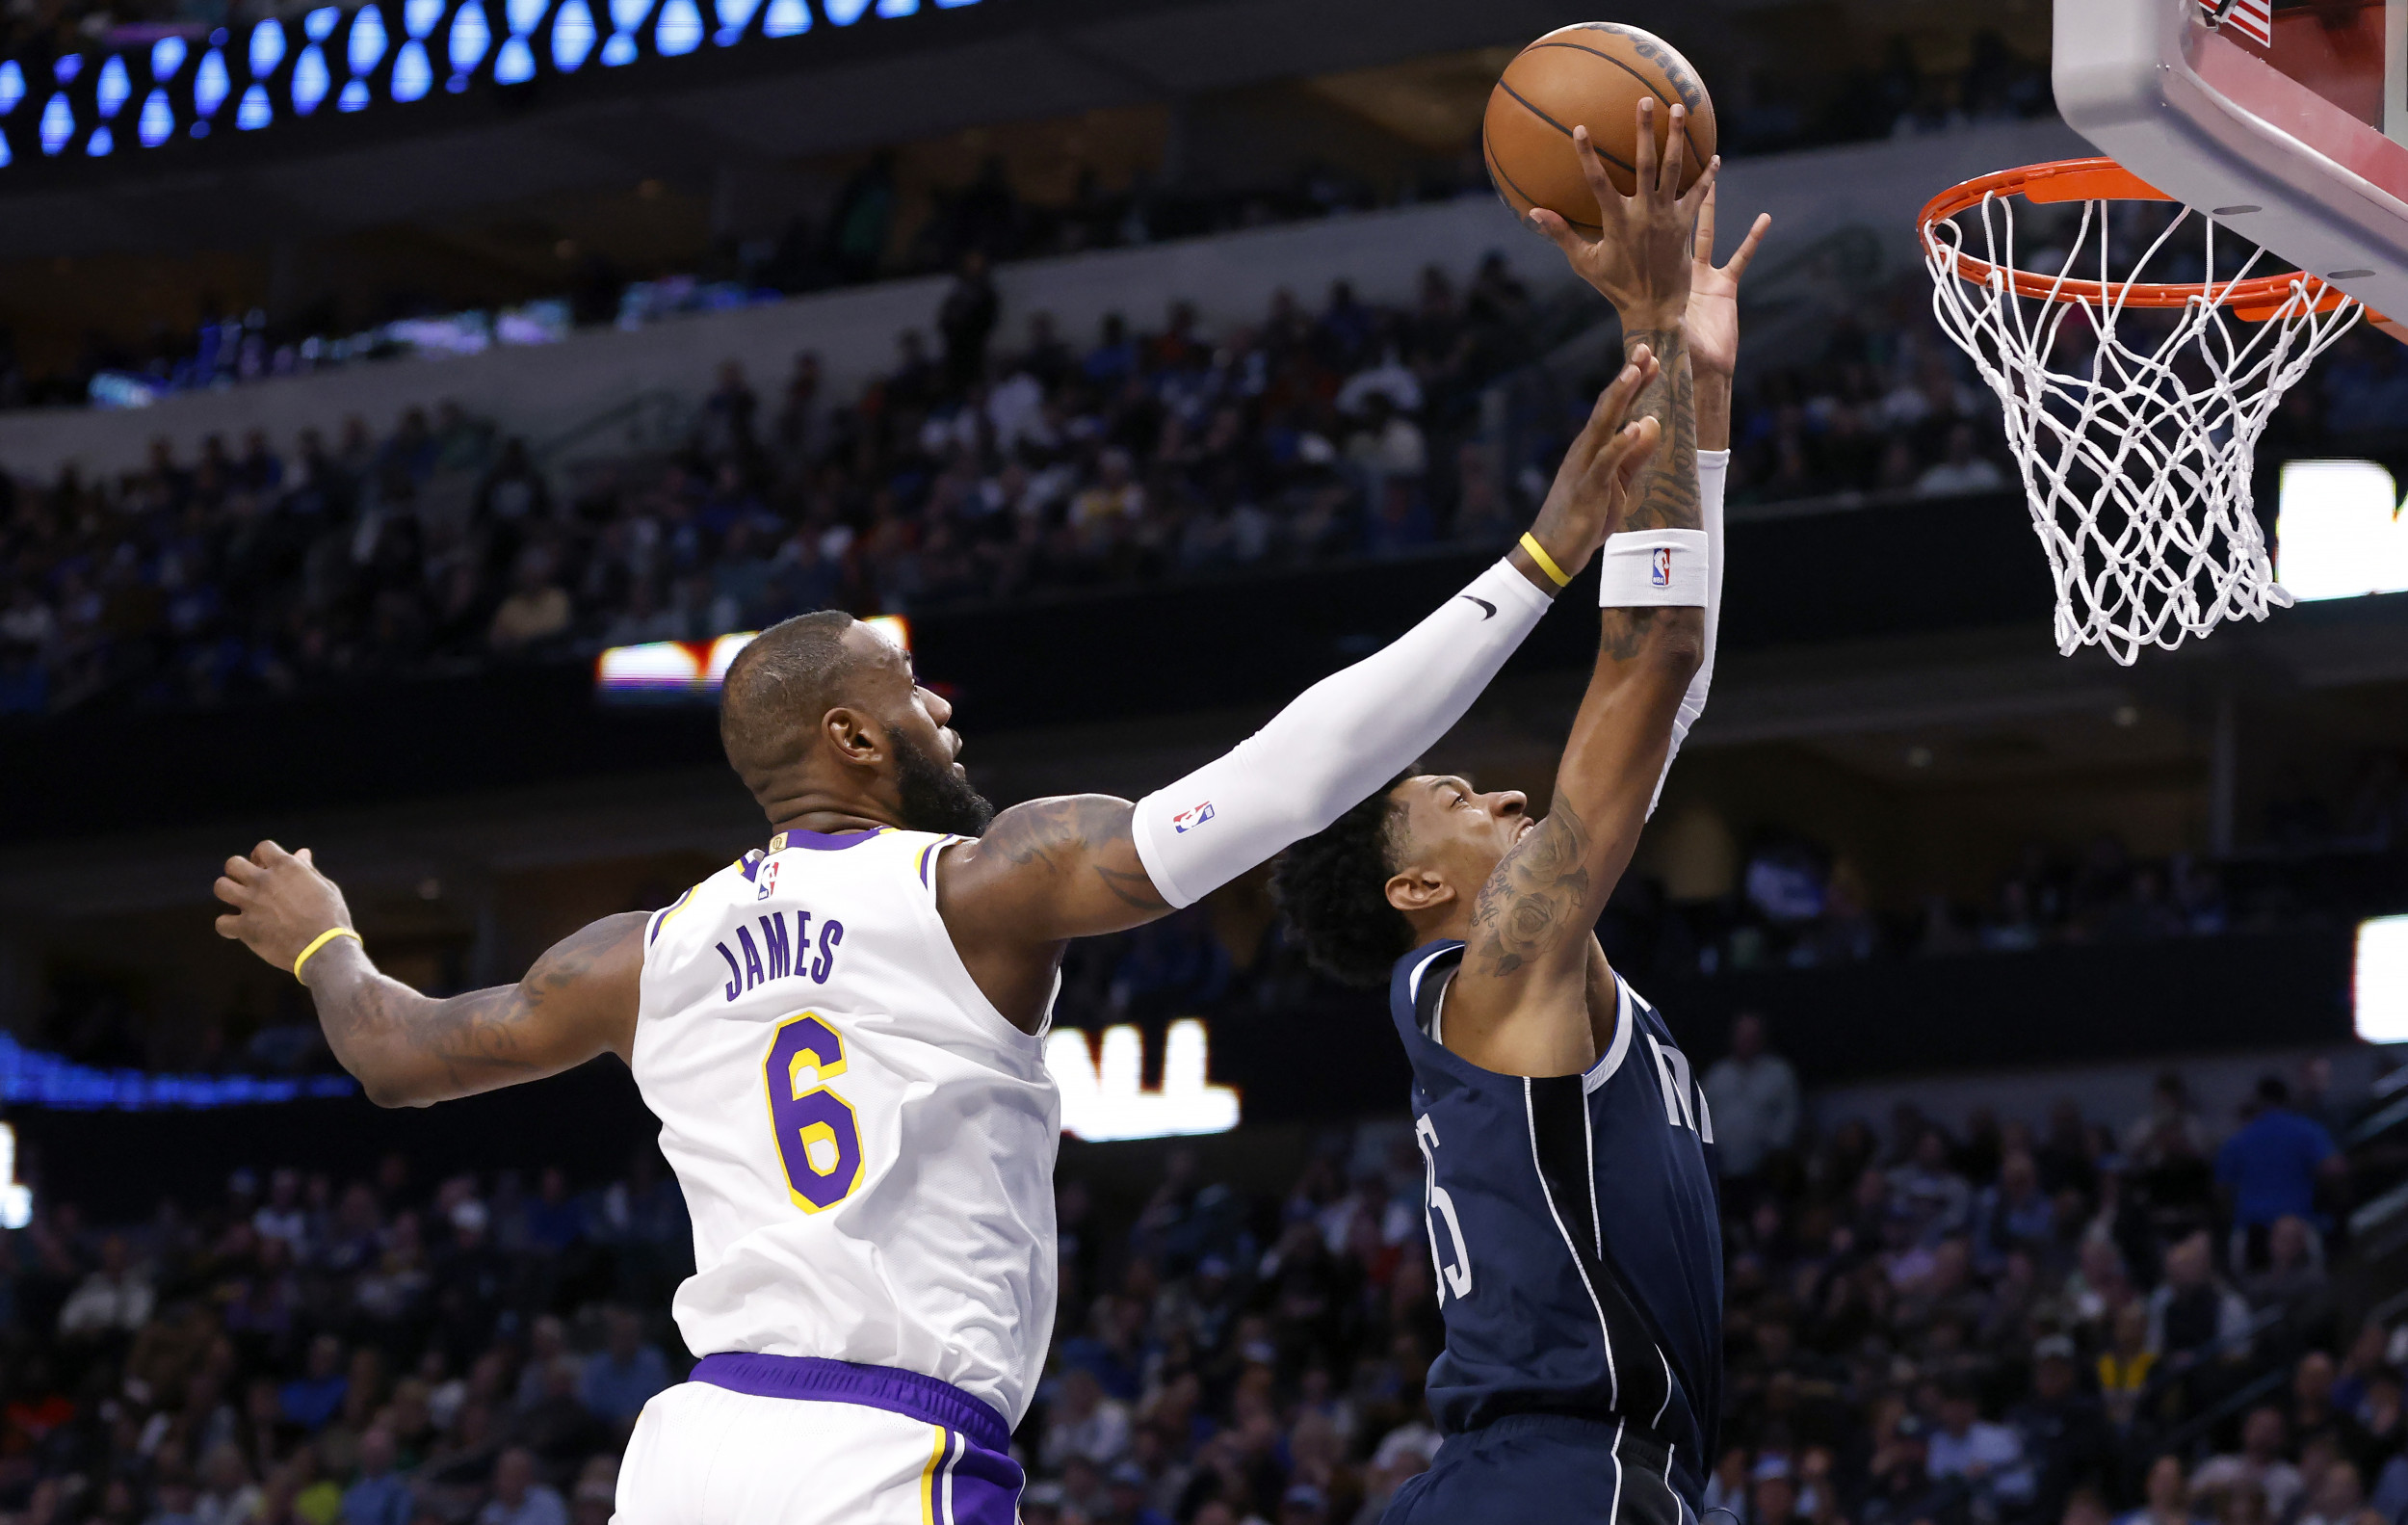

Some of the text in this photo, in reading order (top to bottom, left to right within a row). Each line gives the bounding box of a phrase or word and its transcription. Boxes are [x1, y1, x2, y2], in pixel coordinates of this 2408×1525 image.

[716, 910, 844, 1002] JAMES
[762, 1011, 866, 1215] 6
[1415, 1113, 1472, 1311] 5
